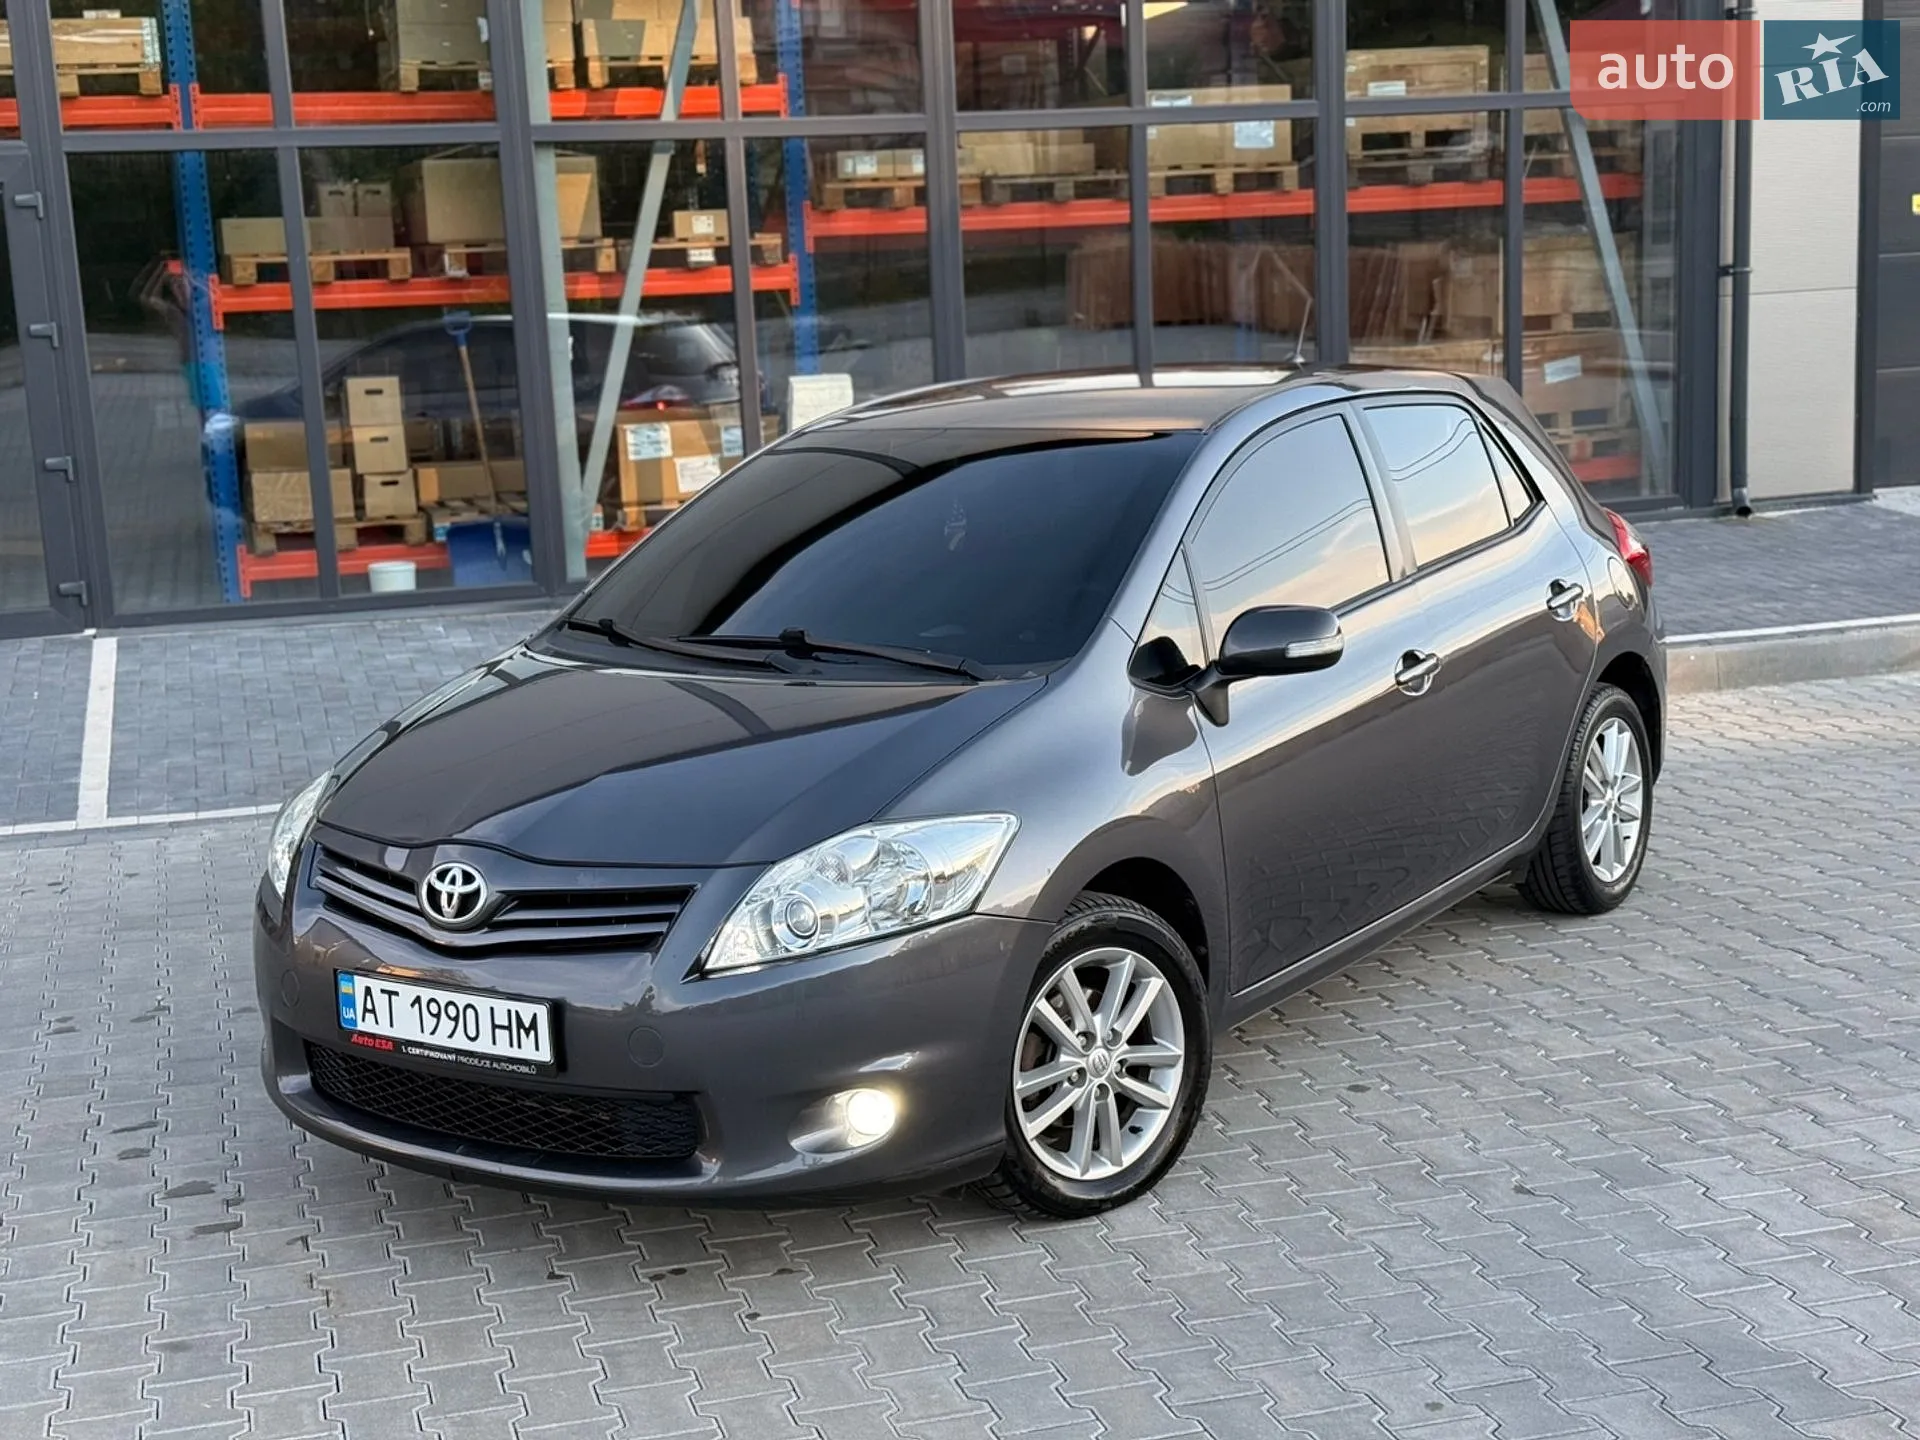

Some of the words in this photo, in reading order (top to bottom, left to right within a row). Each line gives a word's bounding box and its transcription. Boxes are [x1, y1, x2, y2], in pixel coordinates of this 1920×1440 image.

[342, 1007, 356, 1020] UA
[362, 985, 399, 1028] AT
[410, 995, 480, 1042] 1990
[490, 1006, 539, 1051] HM
[351, 1034, 374, 1047] Auto
